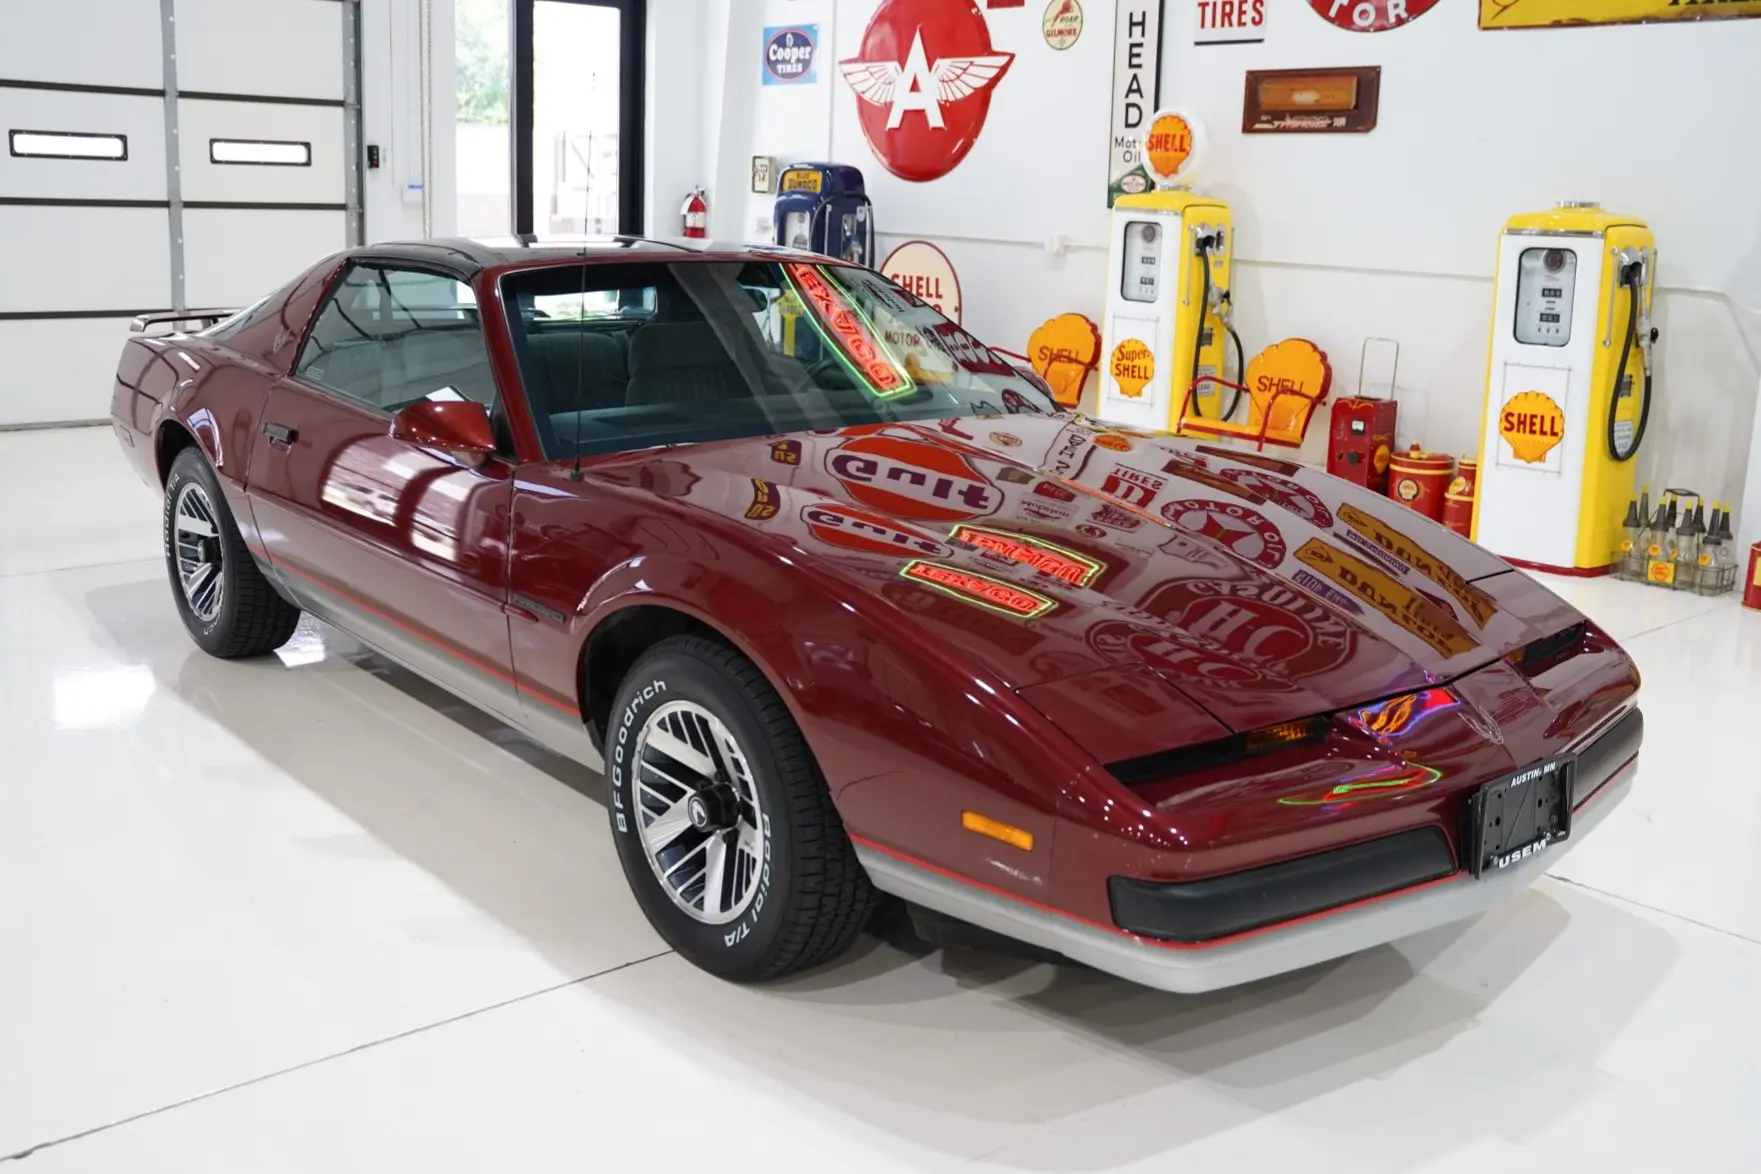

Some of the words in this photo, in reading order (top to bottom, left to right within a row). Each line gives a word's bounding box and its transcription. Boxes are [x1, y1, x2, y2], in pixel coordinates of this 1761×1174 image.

[1197, 0, 1264, 29] TIRES
[1046, 28, 1077, 37] GILMORE
[769, 43, 812, 63] Cooper
[777, 63, 802, 74] TIRES
[1124, 11, 1147, 129] HEAD
[1147, 134, 1187, 152] SHELL
[1123, 151, 1141, 163] Oil
[788, 178, 817, 190] SUNOCO
[891, 274, 943, 298] SHELL
[884, 330, 920, 346] MOTOR
[1116, 344, 1150, 363] Super
[1114, 363, 1150, 380] SHELL
[1503, 411, 1559, 437] SHELL
[1543, 762, 1556, 774] MN
[1499, 839, 1546, 868] USEM
[751, 813, 772, 922] Radial
[724, 922, 750, 947] T/A
